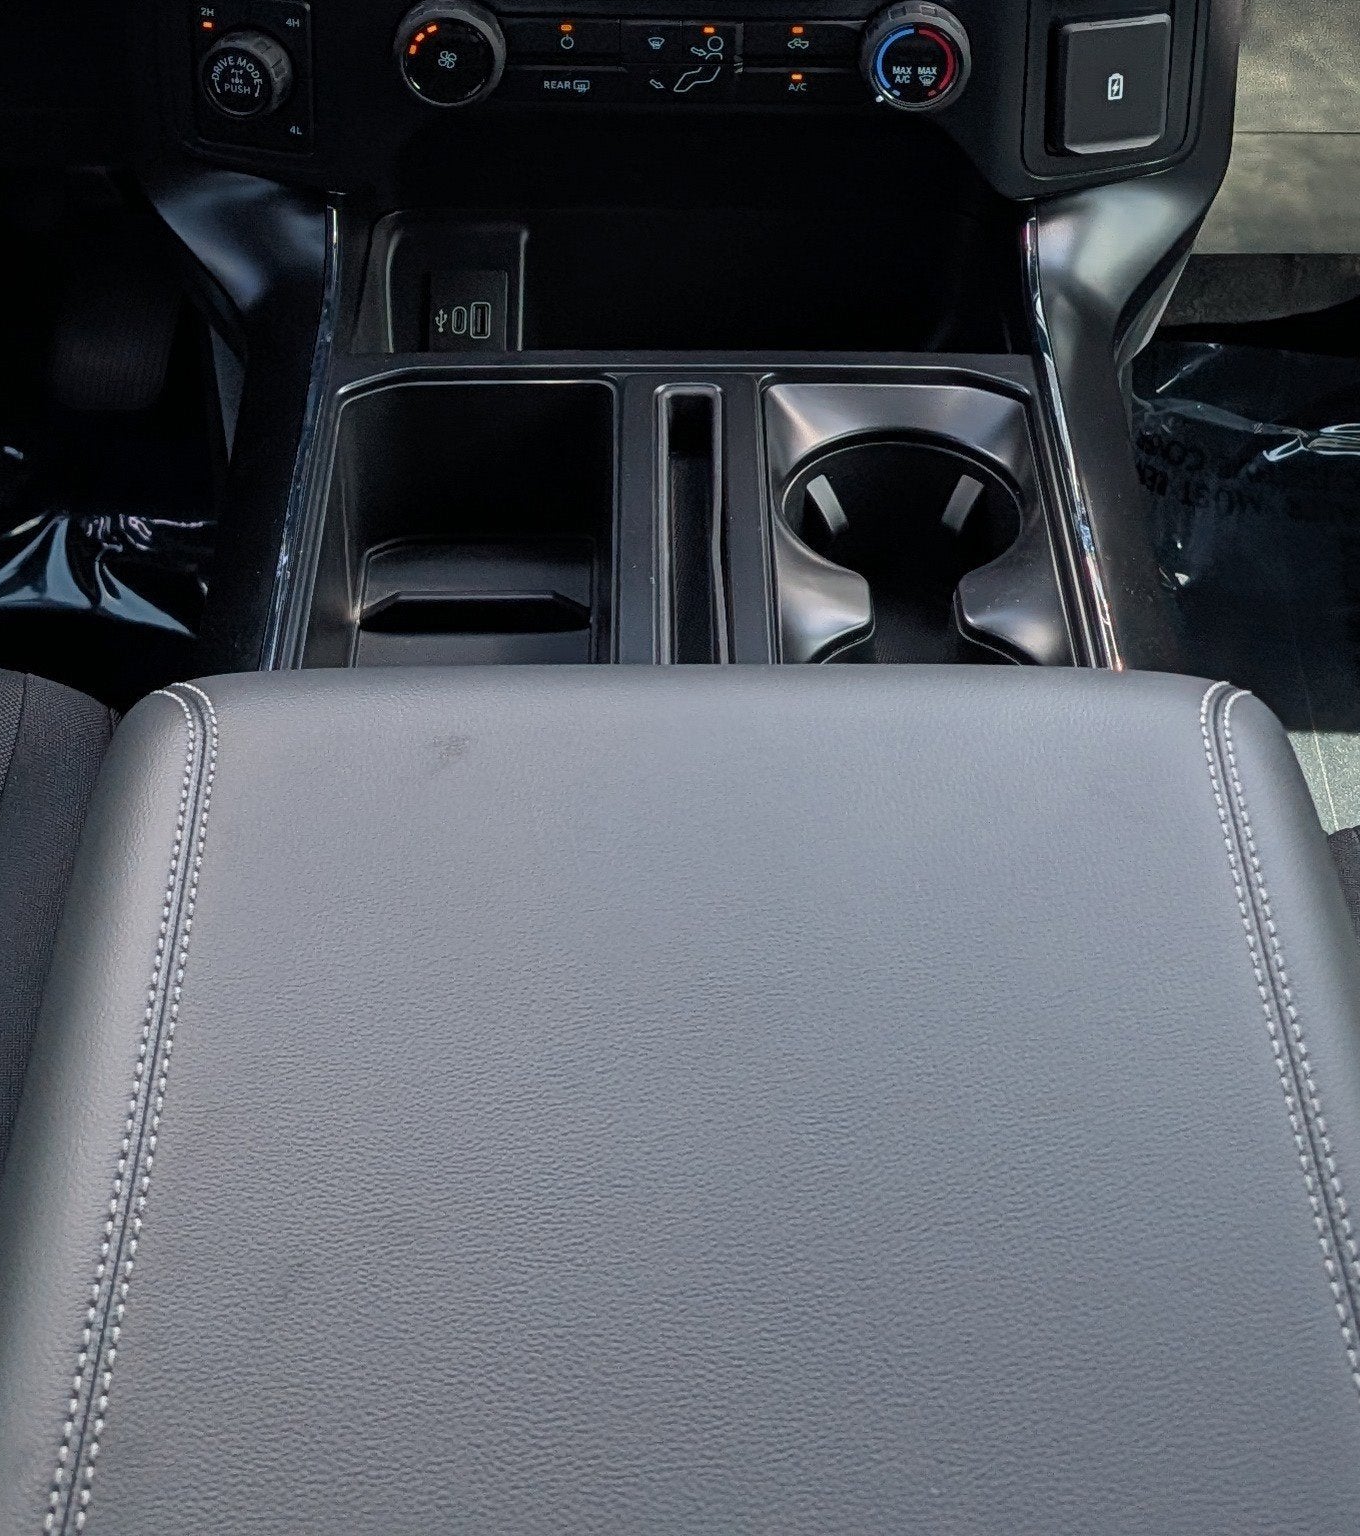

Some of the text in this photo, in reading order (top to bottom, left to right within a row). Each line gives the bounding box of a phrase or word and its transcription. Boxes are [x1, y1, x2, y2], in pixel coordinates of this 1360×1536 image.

[201, 7, 215, 17] 2H
[285, 19, 300, 28] 4H
[212, 56, 263, 85] DRIVE MODE
[892, 66, 912, 75] MAX
[918, 67, 938, 75] MAX
[895, 76, 911, 84] A/C
[225, 84, 251, 95] PUSH
[544, 80, 571, 90] REAR
[789, 82, 807, 92] A/C
[290, 126, 303, 135] 4L
